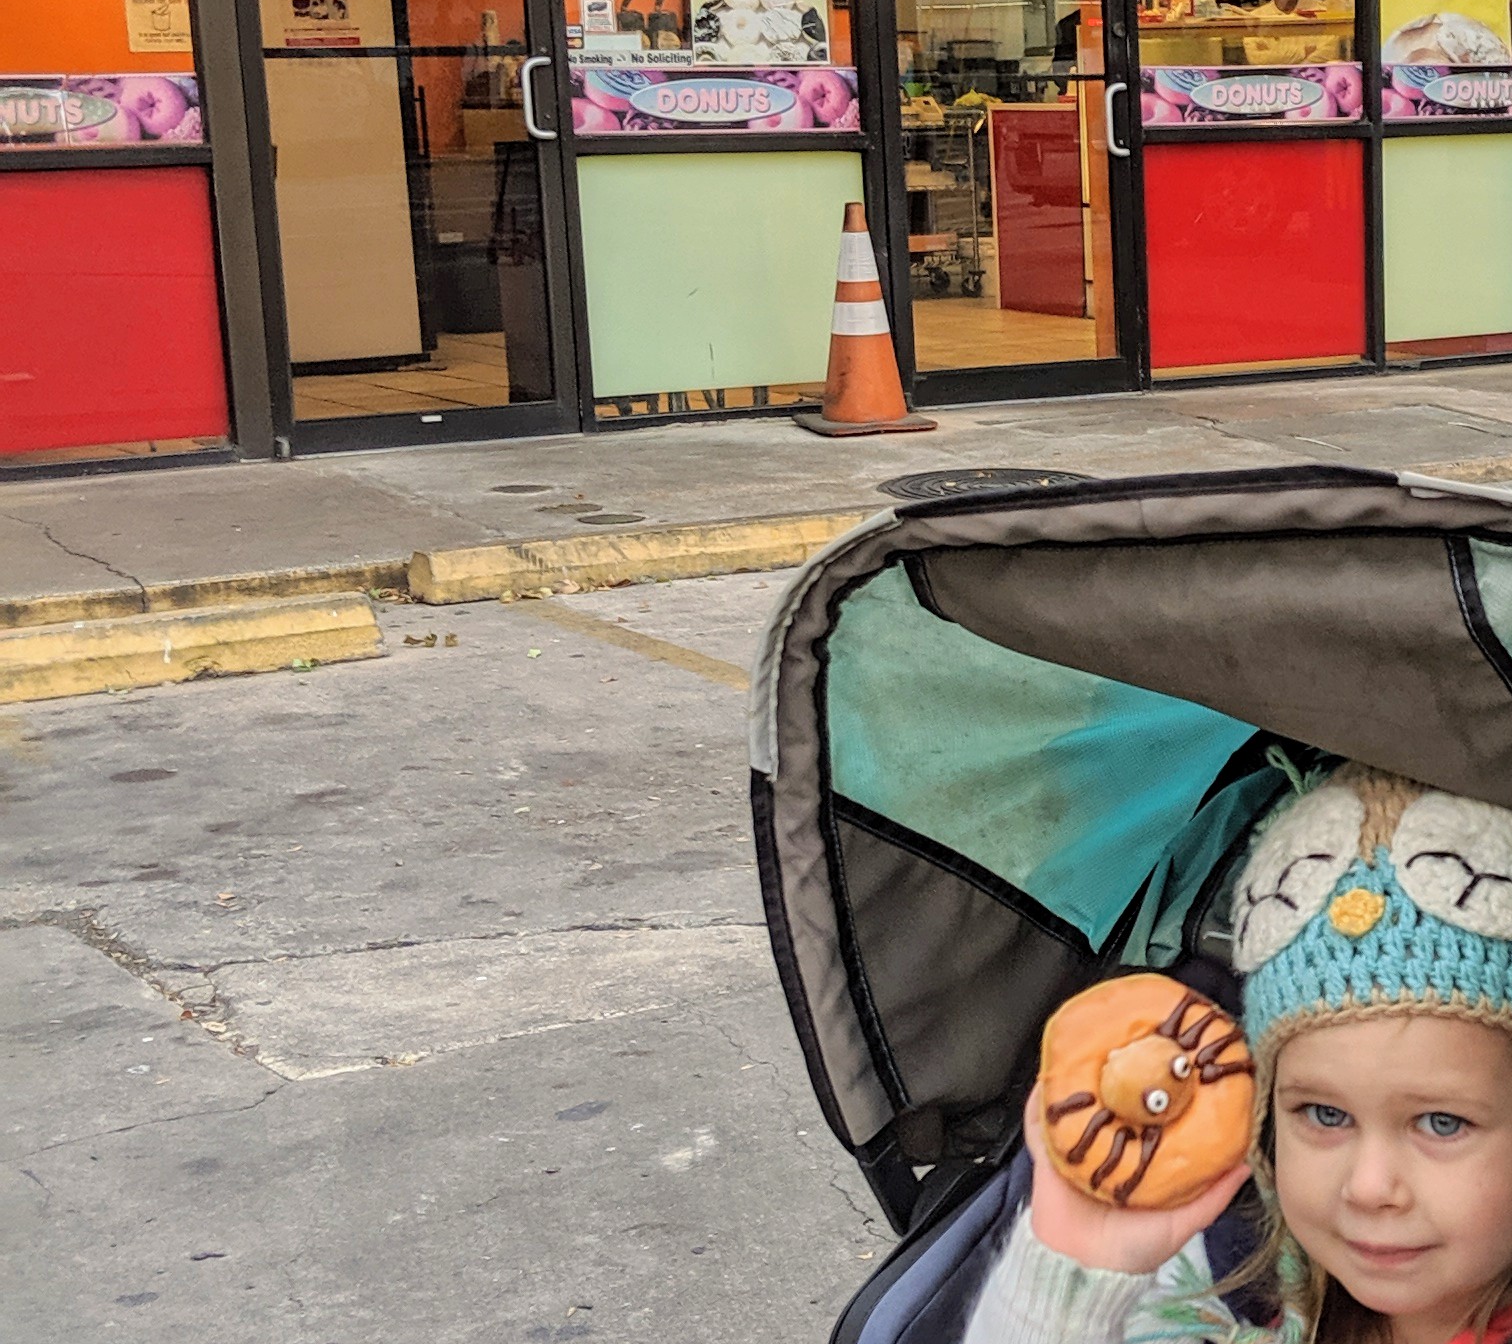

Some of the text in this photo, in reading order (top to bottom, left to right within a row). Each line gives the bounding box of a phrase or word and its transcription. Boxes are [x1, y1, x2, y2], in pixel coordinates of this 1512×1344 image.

[631, 53, 646, 63] No
[647, 53, 692, 66] Soliciting
[656, 87, 772, 114] DONUTS
[1212, 82, 1304, 107] DONUTS
